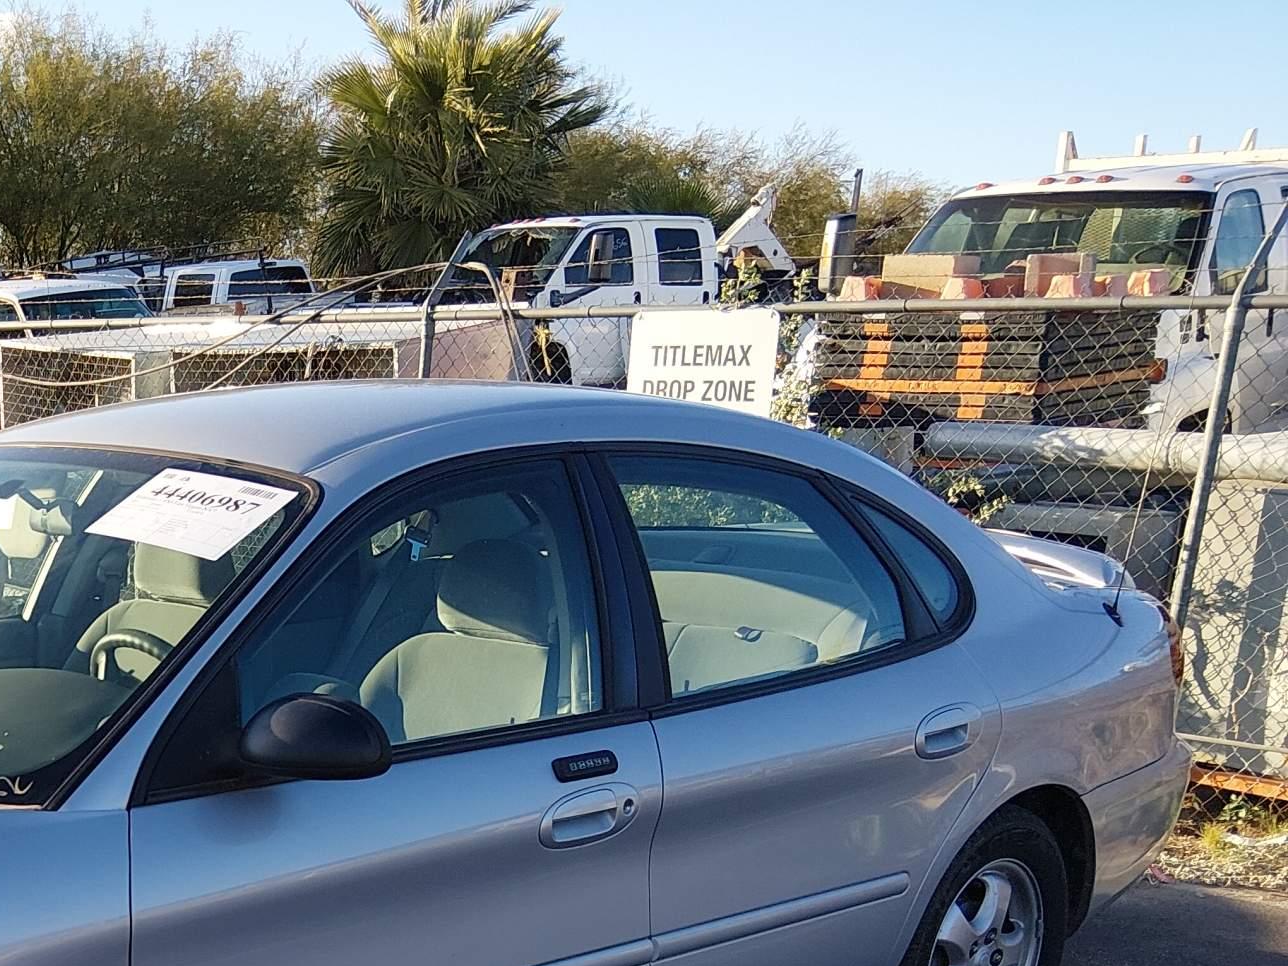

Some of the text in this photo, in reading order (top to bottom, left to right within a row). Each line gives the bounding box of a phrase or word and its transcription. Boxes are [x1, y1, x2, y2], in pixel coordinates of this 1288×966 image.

[650, 344, 753, 367] TITLEMAX
[642, 379, 756, 402] DROP ZONE
[151, 484, 263, 515] 44406987
